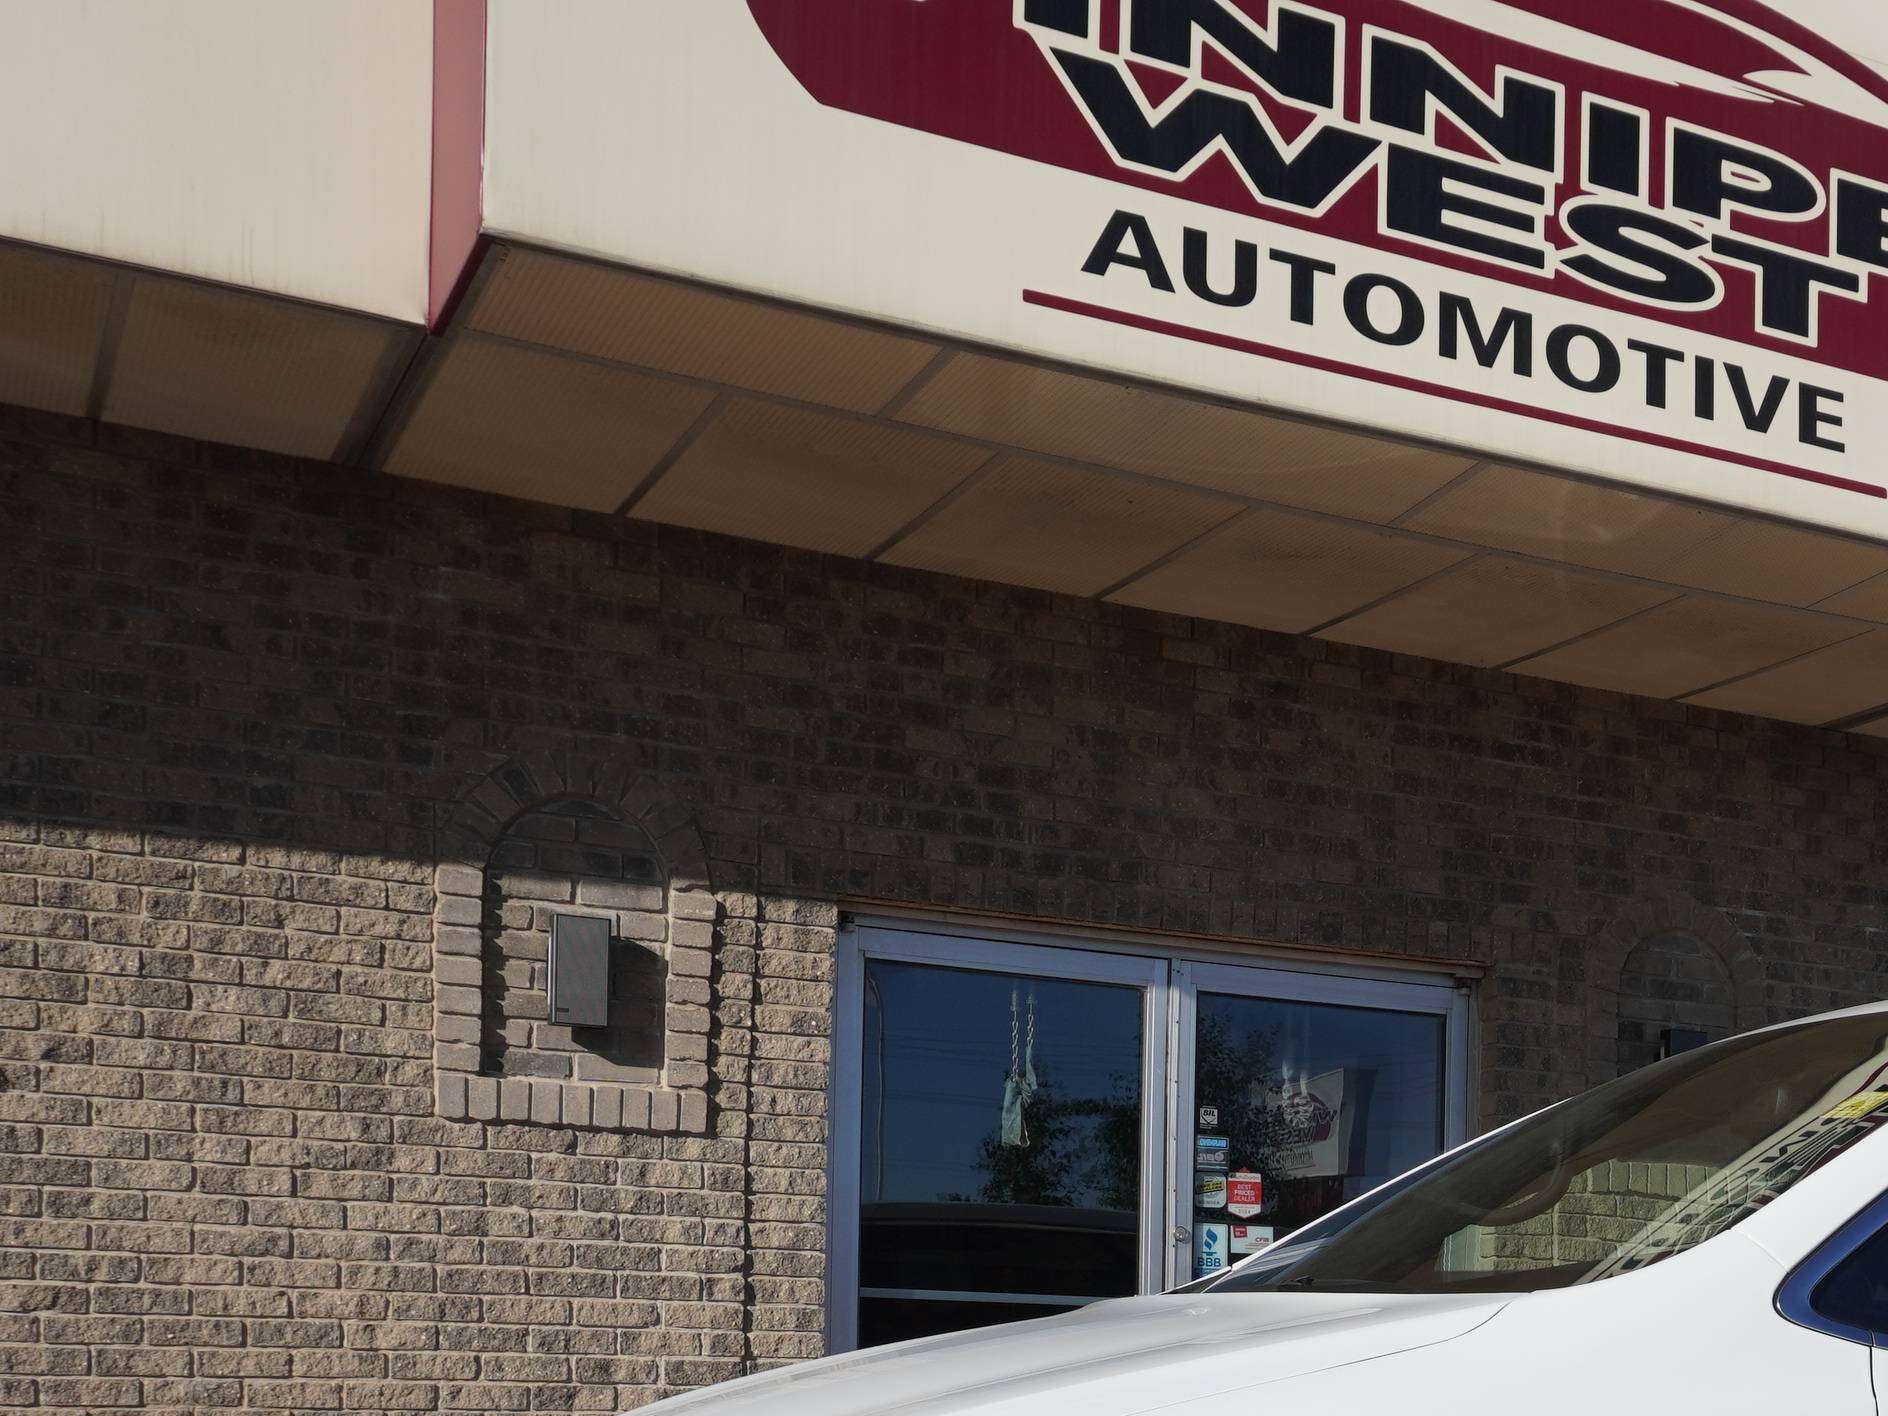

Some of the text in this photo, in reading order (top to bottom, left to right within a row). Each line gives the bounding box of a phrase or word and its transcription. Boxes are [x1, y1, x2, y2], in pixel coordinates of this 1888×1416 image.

[1048, 45, 1861, 340] WEST
[1080, 208, 1847, 455] AUTOMOTIVE
[1196, 1257, 1222, 1268] BBB
